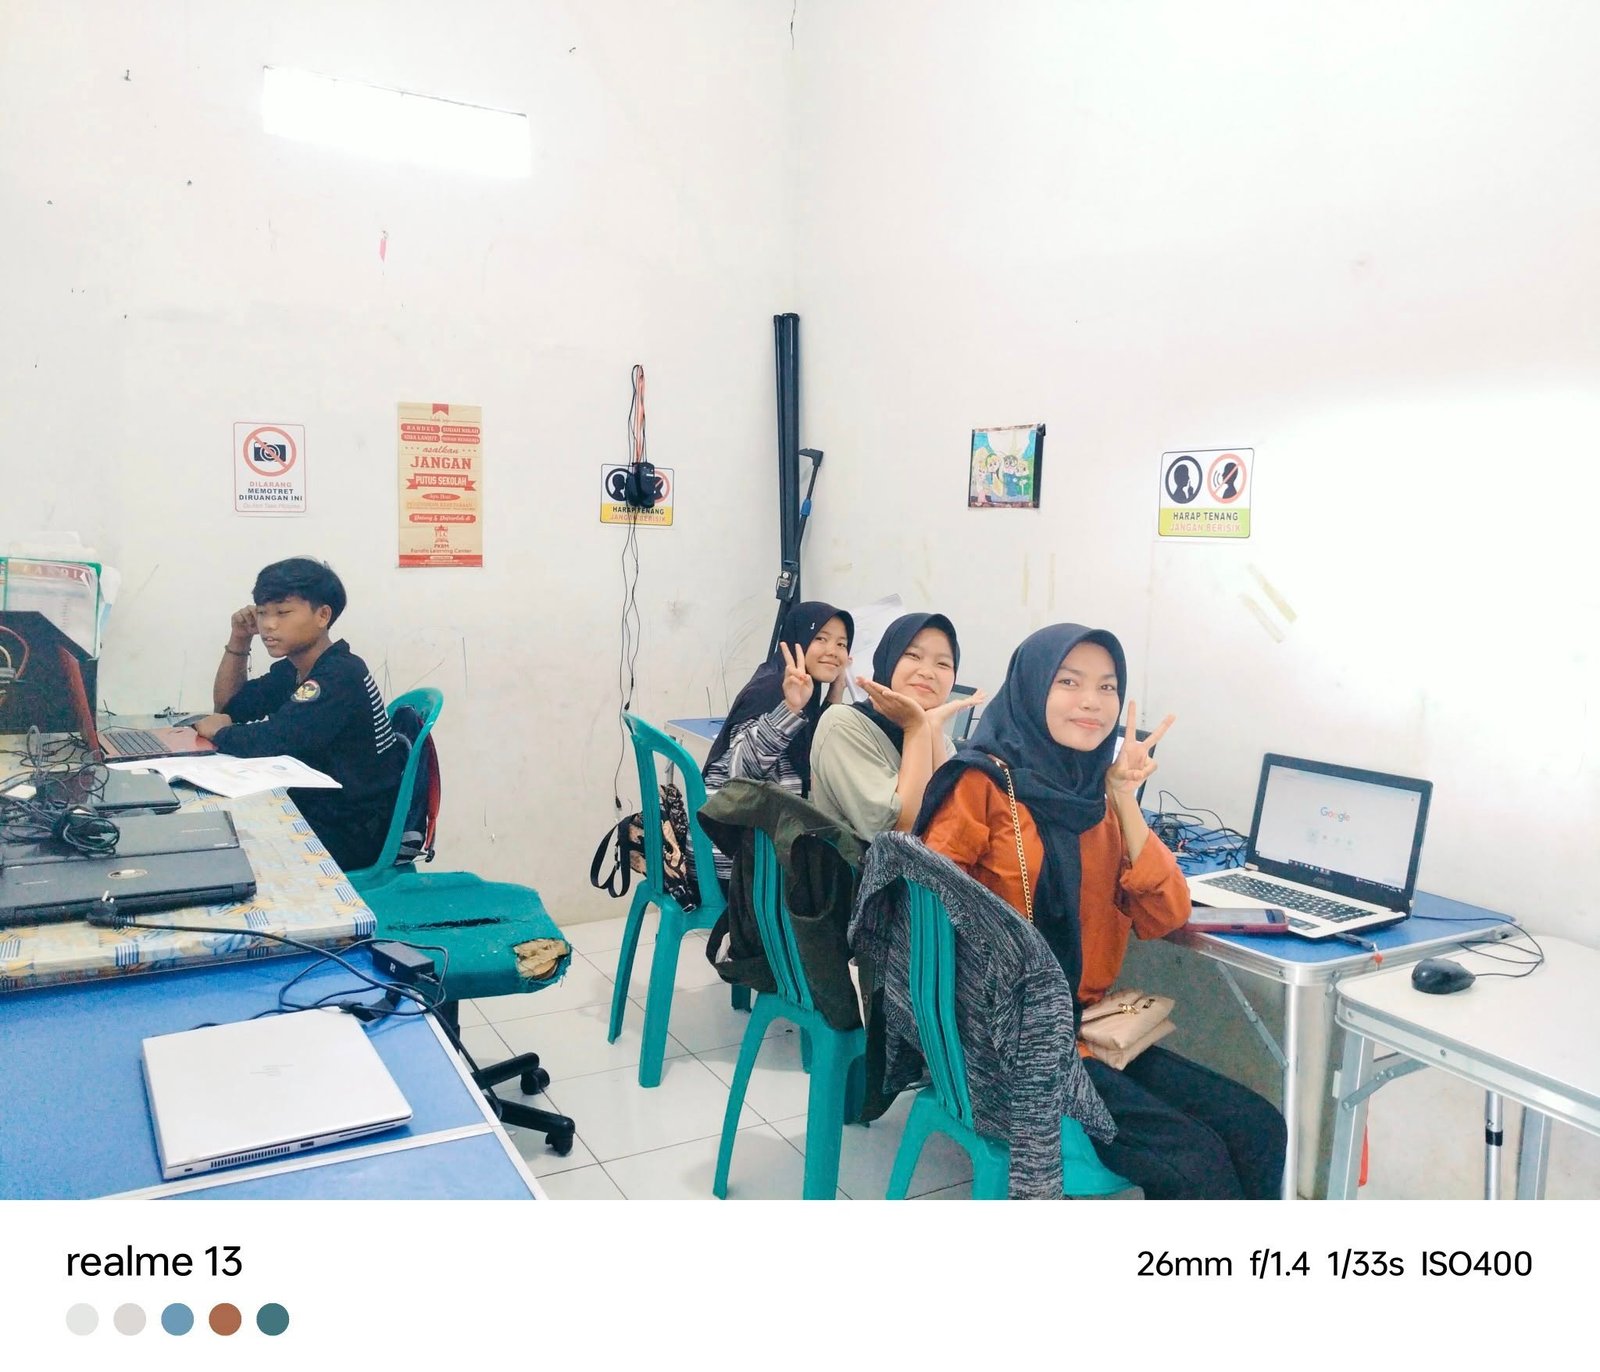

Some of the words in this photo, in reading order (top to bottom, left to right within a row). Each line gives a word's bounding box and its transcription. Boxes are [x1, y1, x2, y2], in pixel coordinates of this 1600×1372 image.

[422, 445, 458, 454] asalkan
[410, 455, 472, 470] JANGAN
[415, 476, 437, 484] PUTUS
[437, 476, 467, 485] SEKOLAH
[1173, 512, 1201, 520] HARAP
[1203, 512, 1238, 520] TENANG
[1169, 523, 1203, 531] JANGAN
[1206, 524, 1240, 532] BERISIK
[1320, 805, 1351, 823] Google
